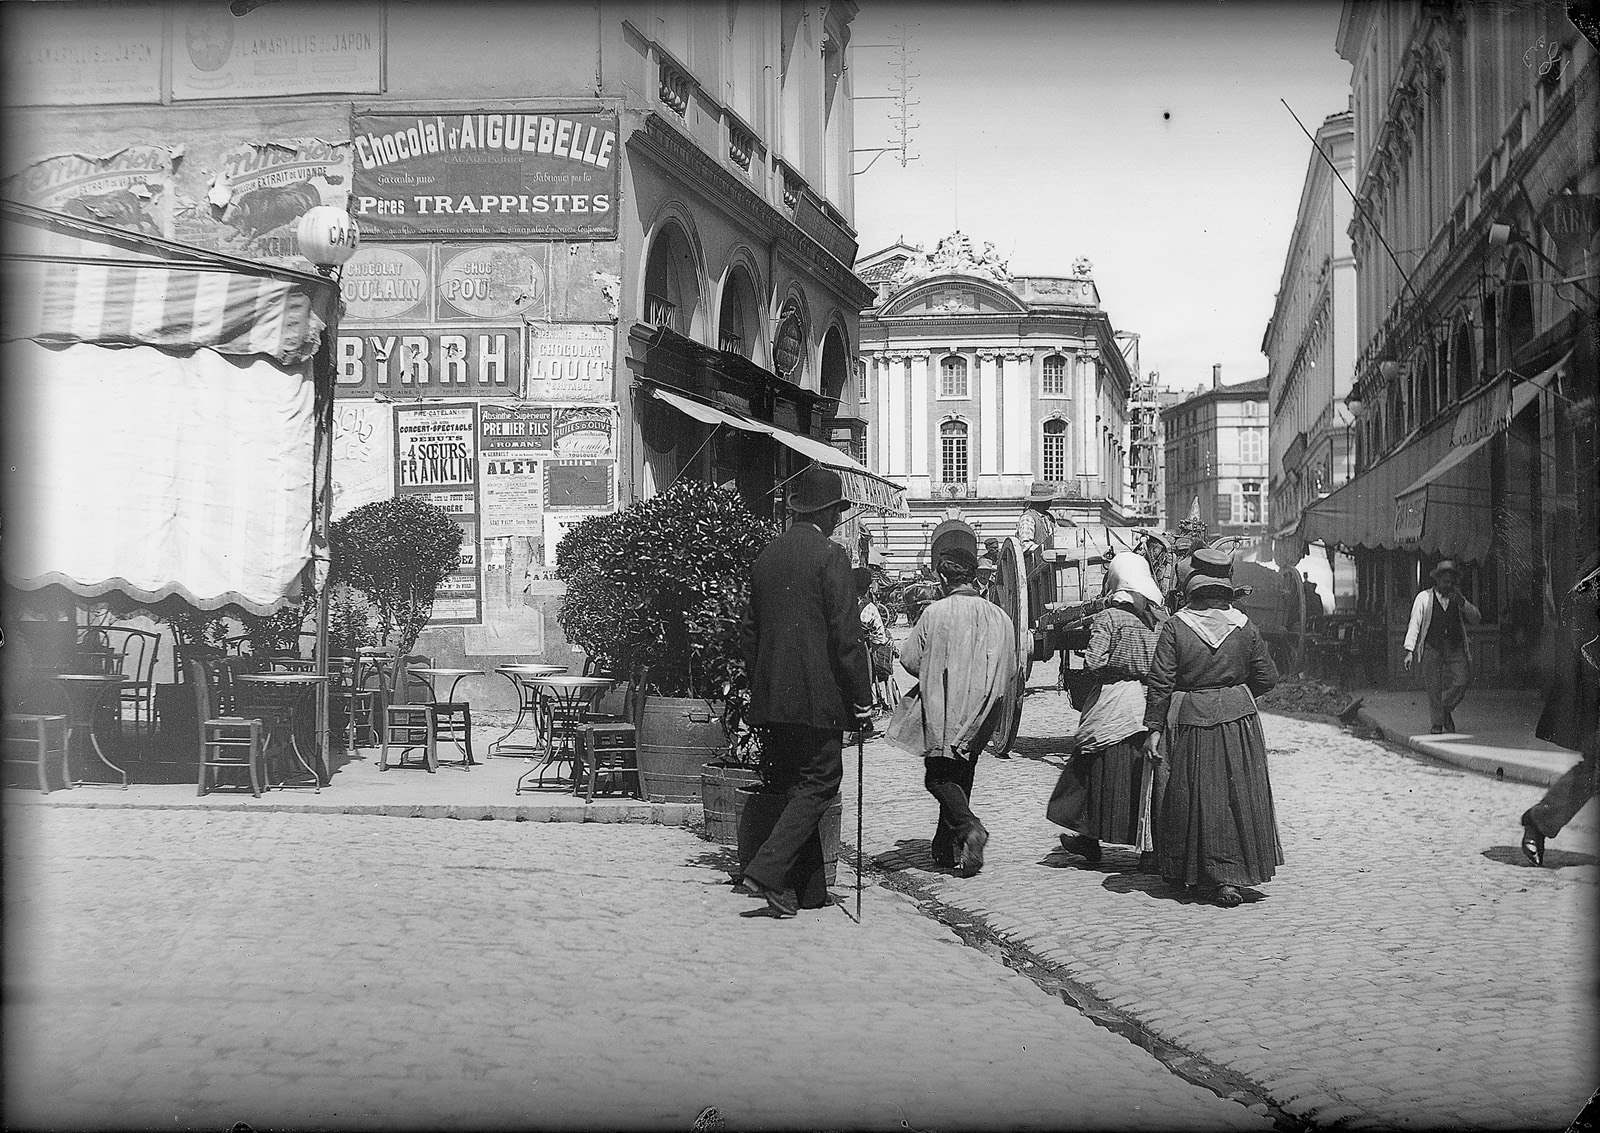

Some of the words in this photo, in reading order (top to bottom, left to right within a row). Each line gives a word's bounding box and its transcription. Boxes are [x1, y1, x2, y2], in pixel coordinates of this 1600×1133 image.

[333, 32, 371, 52] JAPON
[355, 116, 446, 169] Chocolat
[257, 171, 289, 188] EXTRAIT
[297, 166, 328, 179] VIANDE
[358, 196, 405, 214] Pères
[413, 194, 610, 214] TRAPPISTES
[346, 263, 403, 277] CHOCOLAT
[343, 279, 420, 301] OULAIN
[337, 335, 505, 384] BYRRH
[540, 344, 603, 358] CHOCOLAT
[532, 359, 609, 382] LOUIT
[481, 410, 512, 422] Absinthe
[529, 422, 549, 436] FILS
[408, 444, 416, 460] 4
[401, 458, 472, 485] FRANKLIN
[487, 461, 537, 475] ALET
